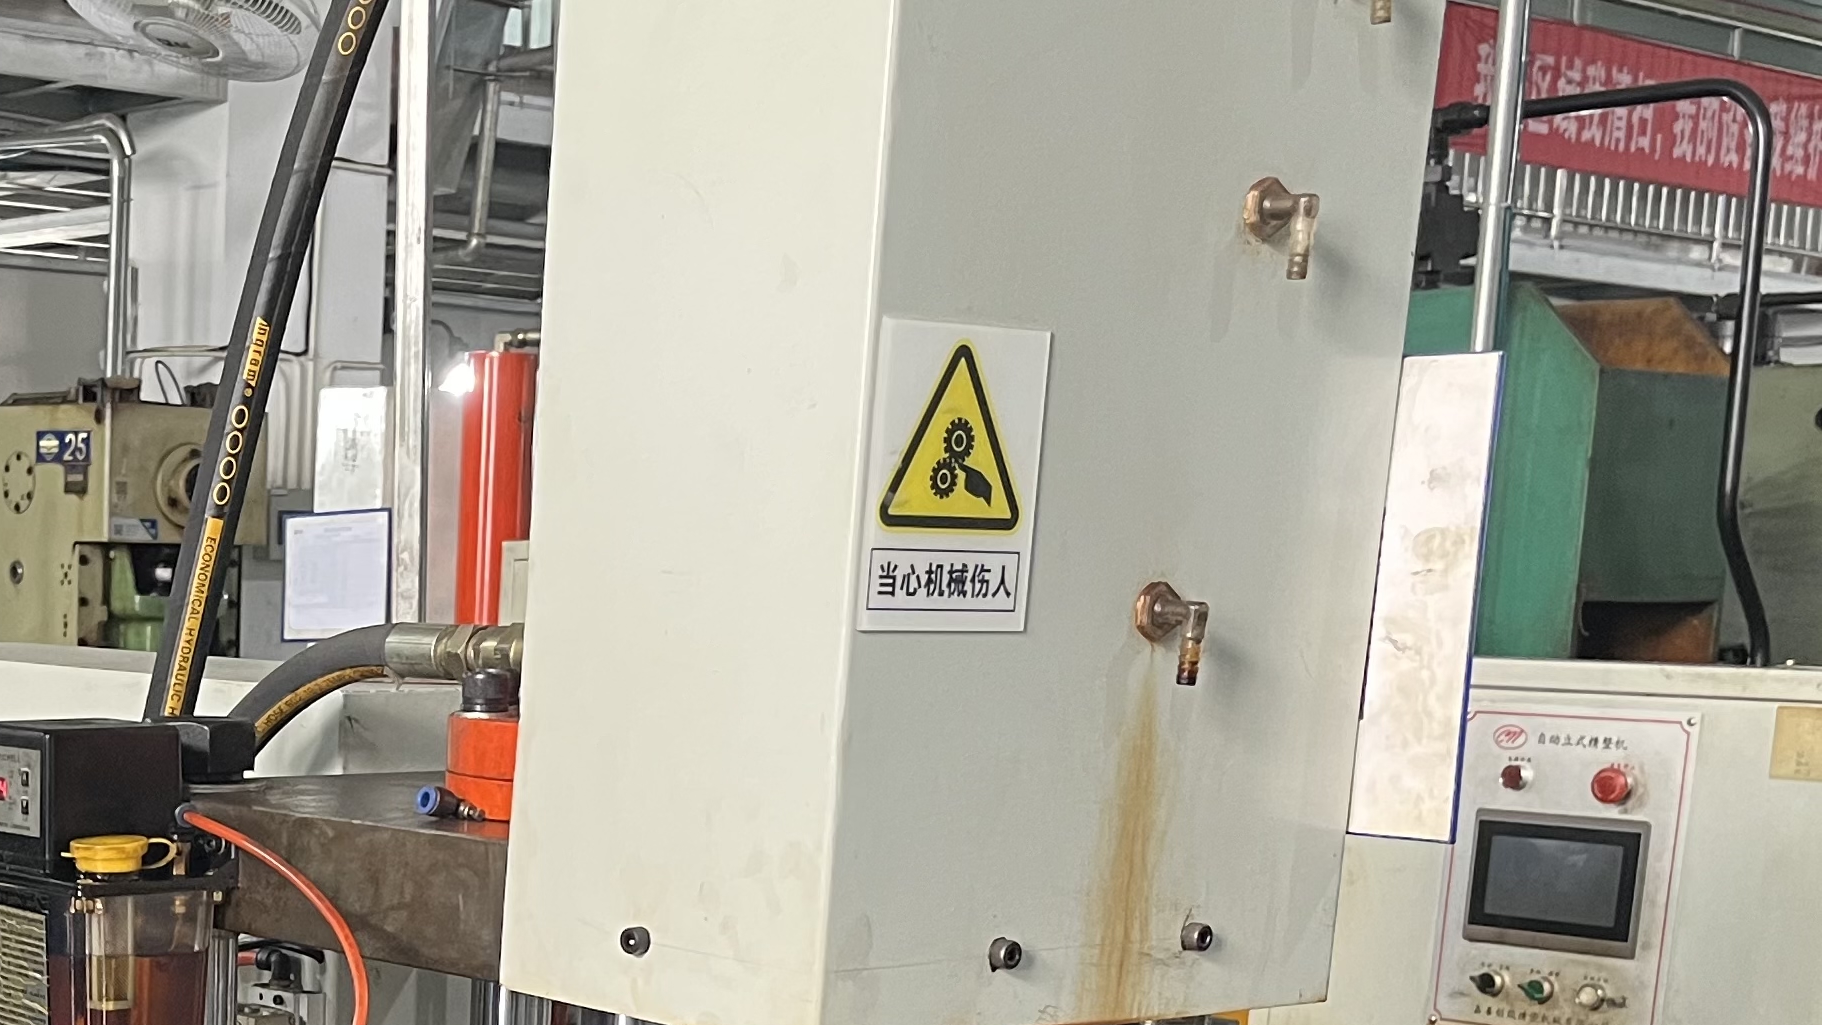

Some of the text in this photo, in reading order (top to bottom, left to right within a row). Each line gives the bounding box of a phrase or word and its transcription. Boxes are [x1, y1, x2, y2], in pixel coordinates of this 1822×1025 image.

[62, 431, 89, 461] 25
[187, 536, 218, 622] ECONOMICAL
[876, 560, 1012, 600] 当心机械伤人
[170, 628, 197, 703] HYDRAULIC
